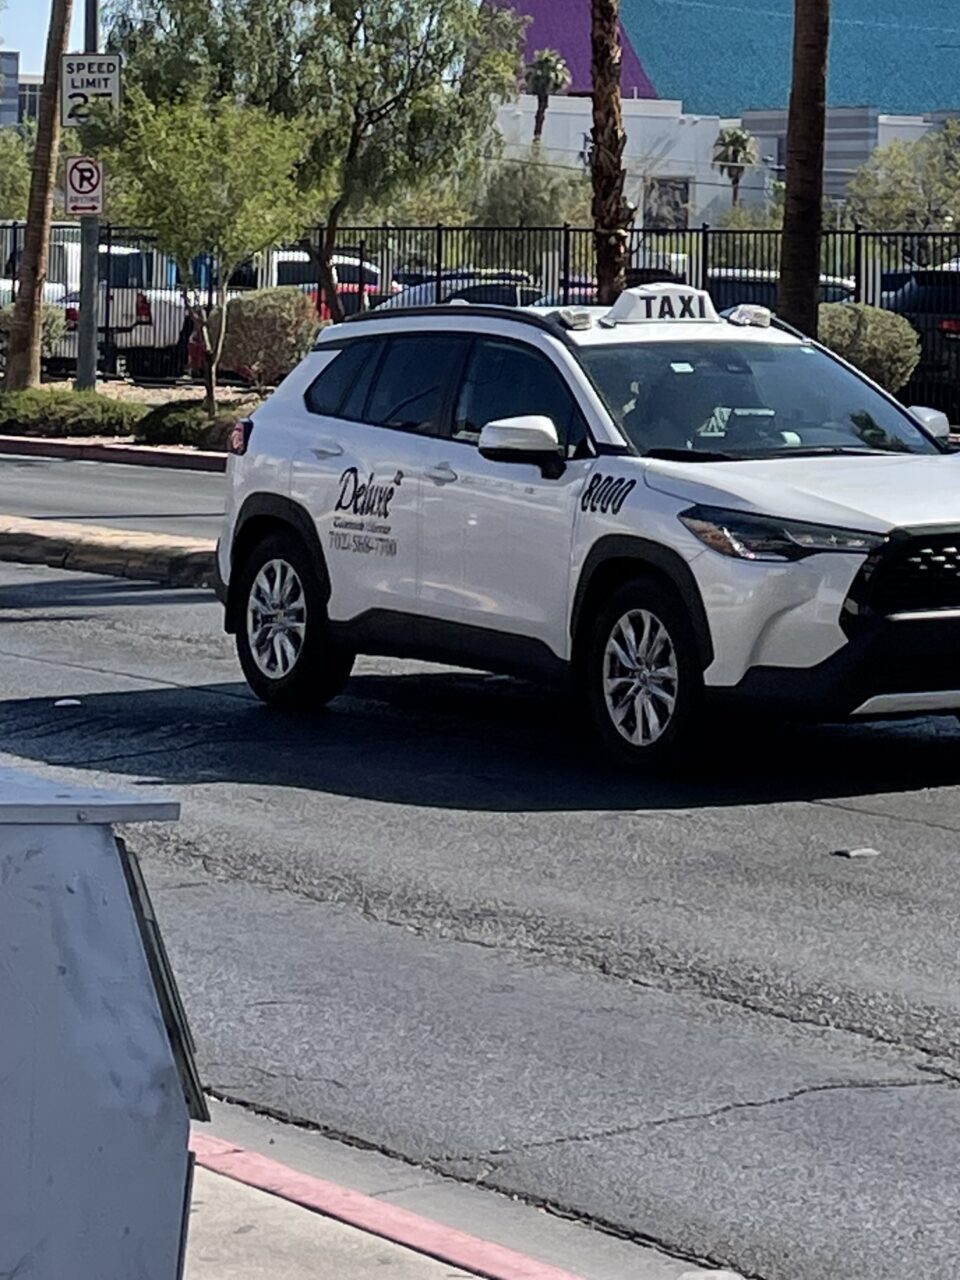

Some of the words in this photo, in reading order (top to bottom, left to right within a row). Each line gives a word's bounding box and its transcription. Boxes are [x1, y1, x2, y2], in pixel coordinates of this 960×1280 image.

[66, 62, 116, 74] SPEED
[71, 78, 110, 89] LIMIT
[639, 295, 706, 318] TAXI
[581, 473, 637, 515] 8000
